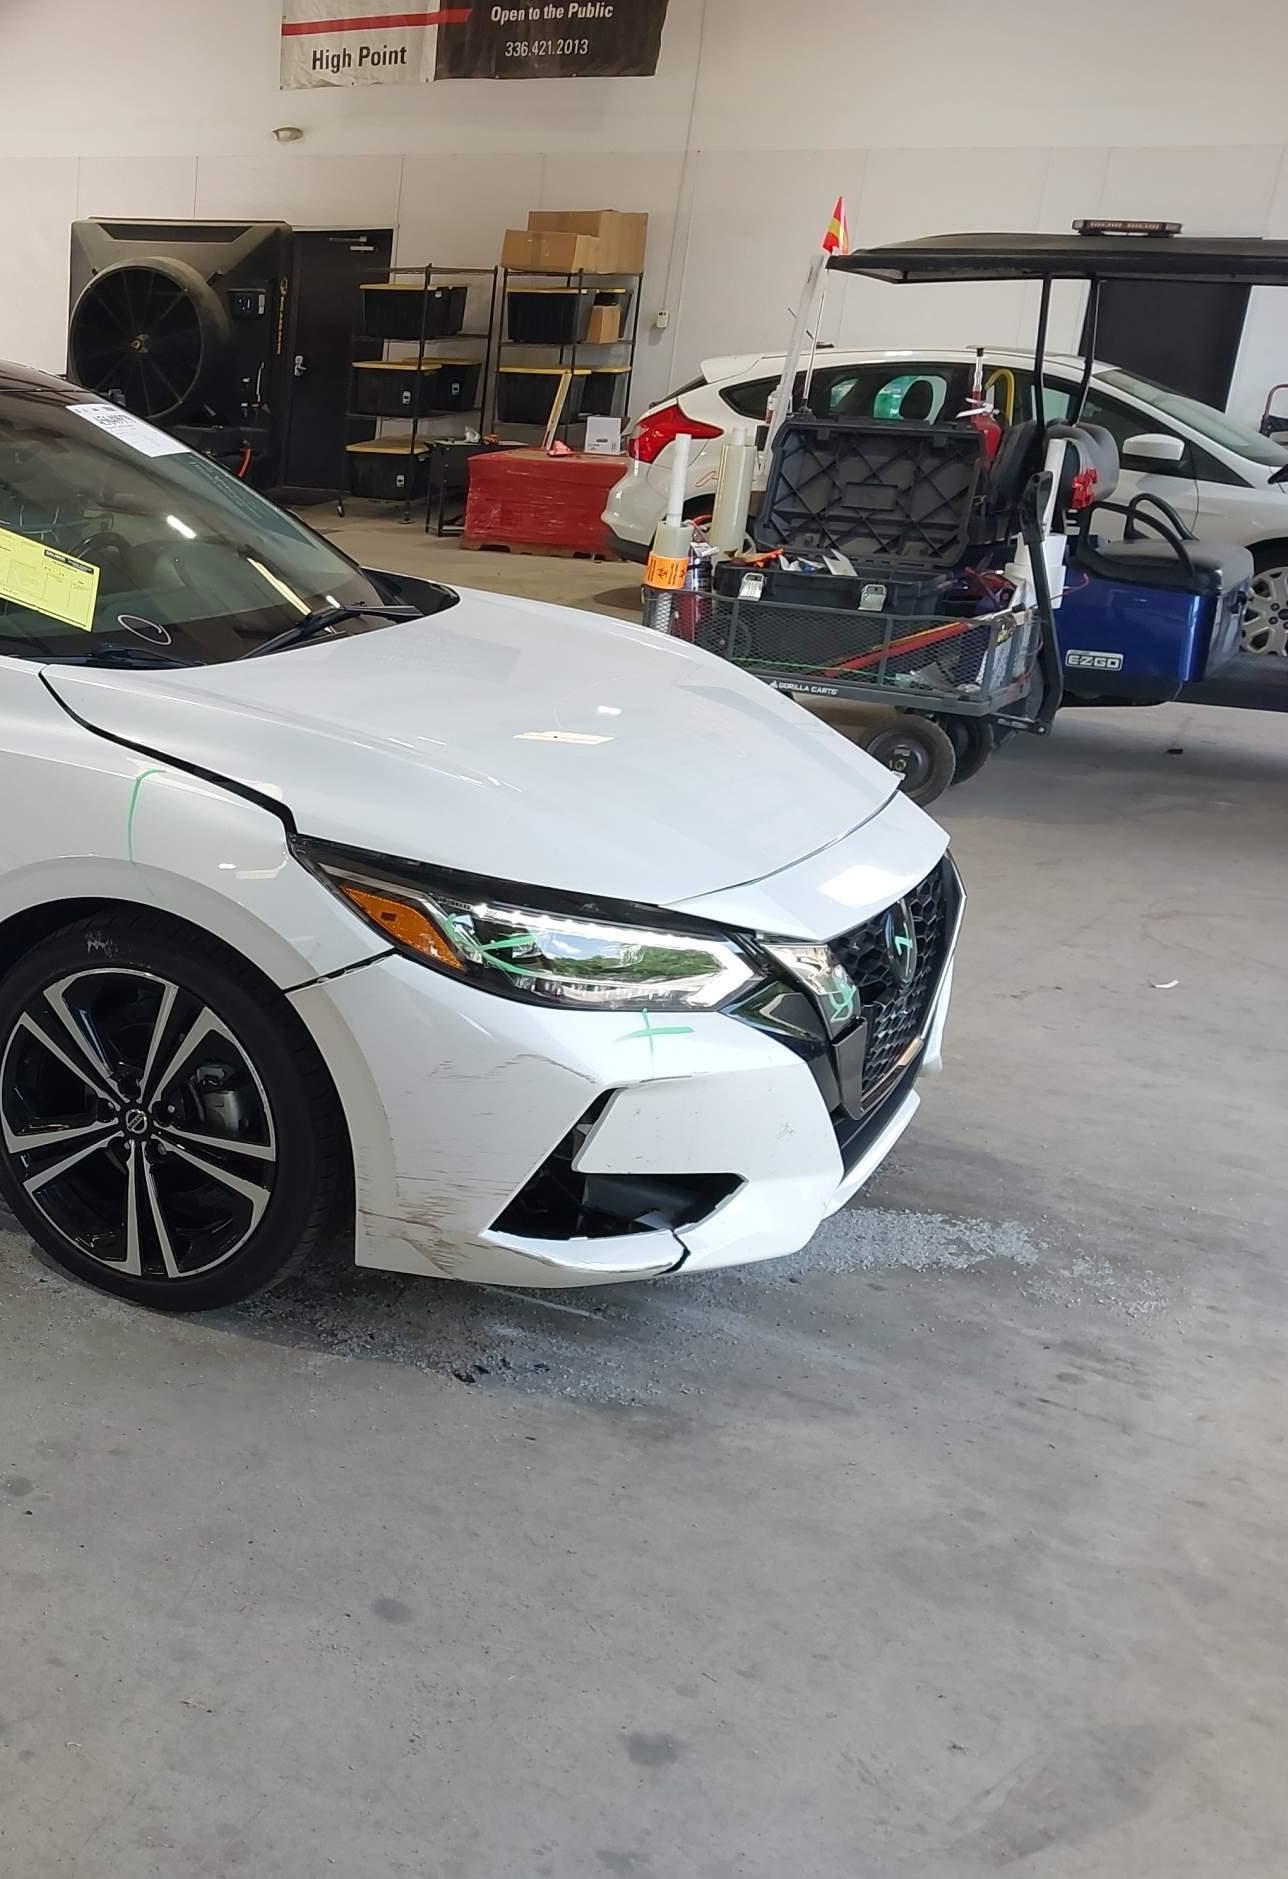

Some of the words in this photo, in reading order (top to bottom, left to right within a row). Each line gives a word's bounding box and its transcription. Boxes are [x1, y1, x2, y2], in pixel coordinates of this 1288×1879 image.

[491, 6, 525, 26] Open
[528, 7, 541, 20] to
[543, 4, 565, 20] the
[567, 2, 614, 18] Public
[504, 39, 589, 57] 336.421.2013
[312, 47, 352, 74] High
[358, 44, 408, 67] Point
[778, 682, 810, 693] GORILLA
[811, 686, 838, 696] CARTS
